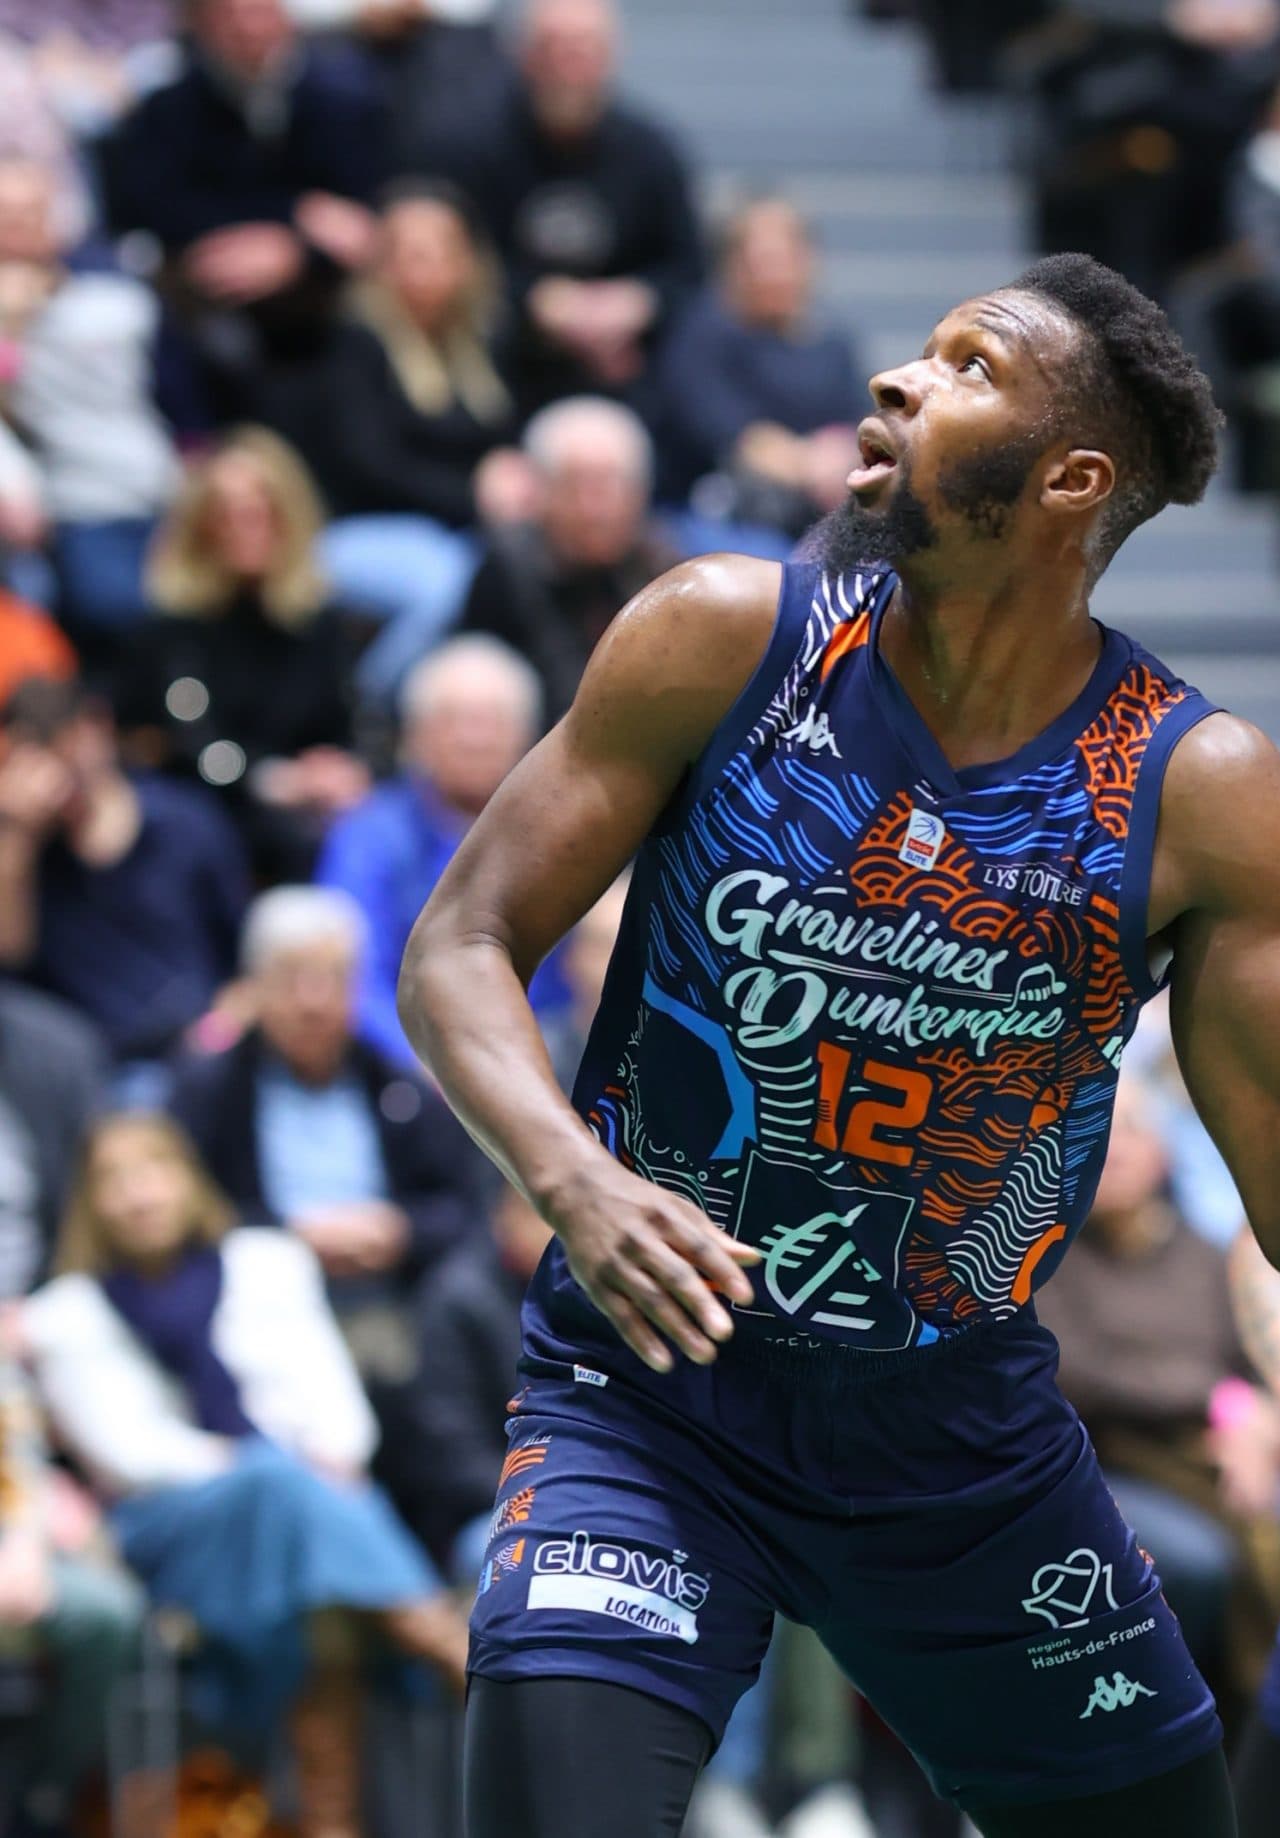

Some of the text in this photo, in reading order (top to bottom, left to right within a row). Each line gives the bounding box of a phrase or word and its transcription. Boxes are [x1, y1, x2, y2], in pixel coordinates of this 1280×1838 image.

[983, 867, 1020, 890] LYS
[705, 868, 1009, 990] Gravelines
[723, 966, 1066, 1056] Dunkerque
[813, 1041, 933, 1167] 12
[533, 1530, 710, 1611] clovis
[603, 1596, 681, 1635] LOCATION
[1031, 1616, 1156, 1670] Hauts-de-France
